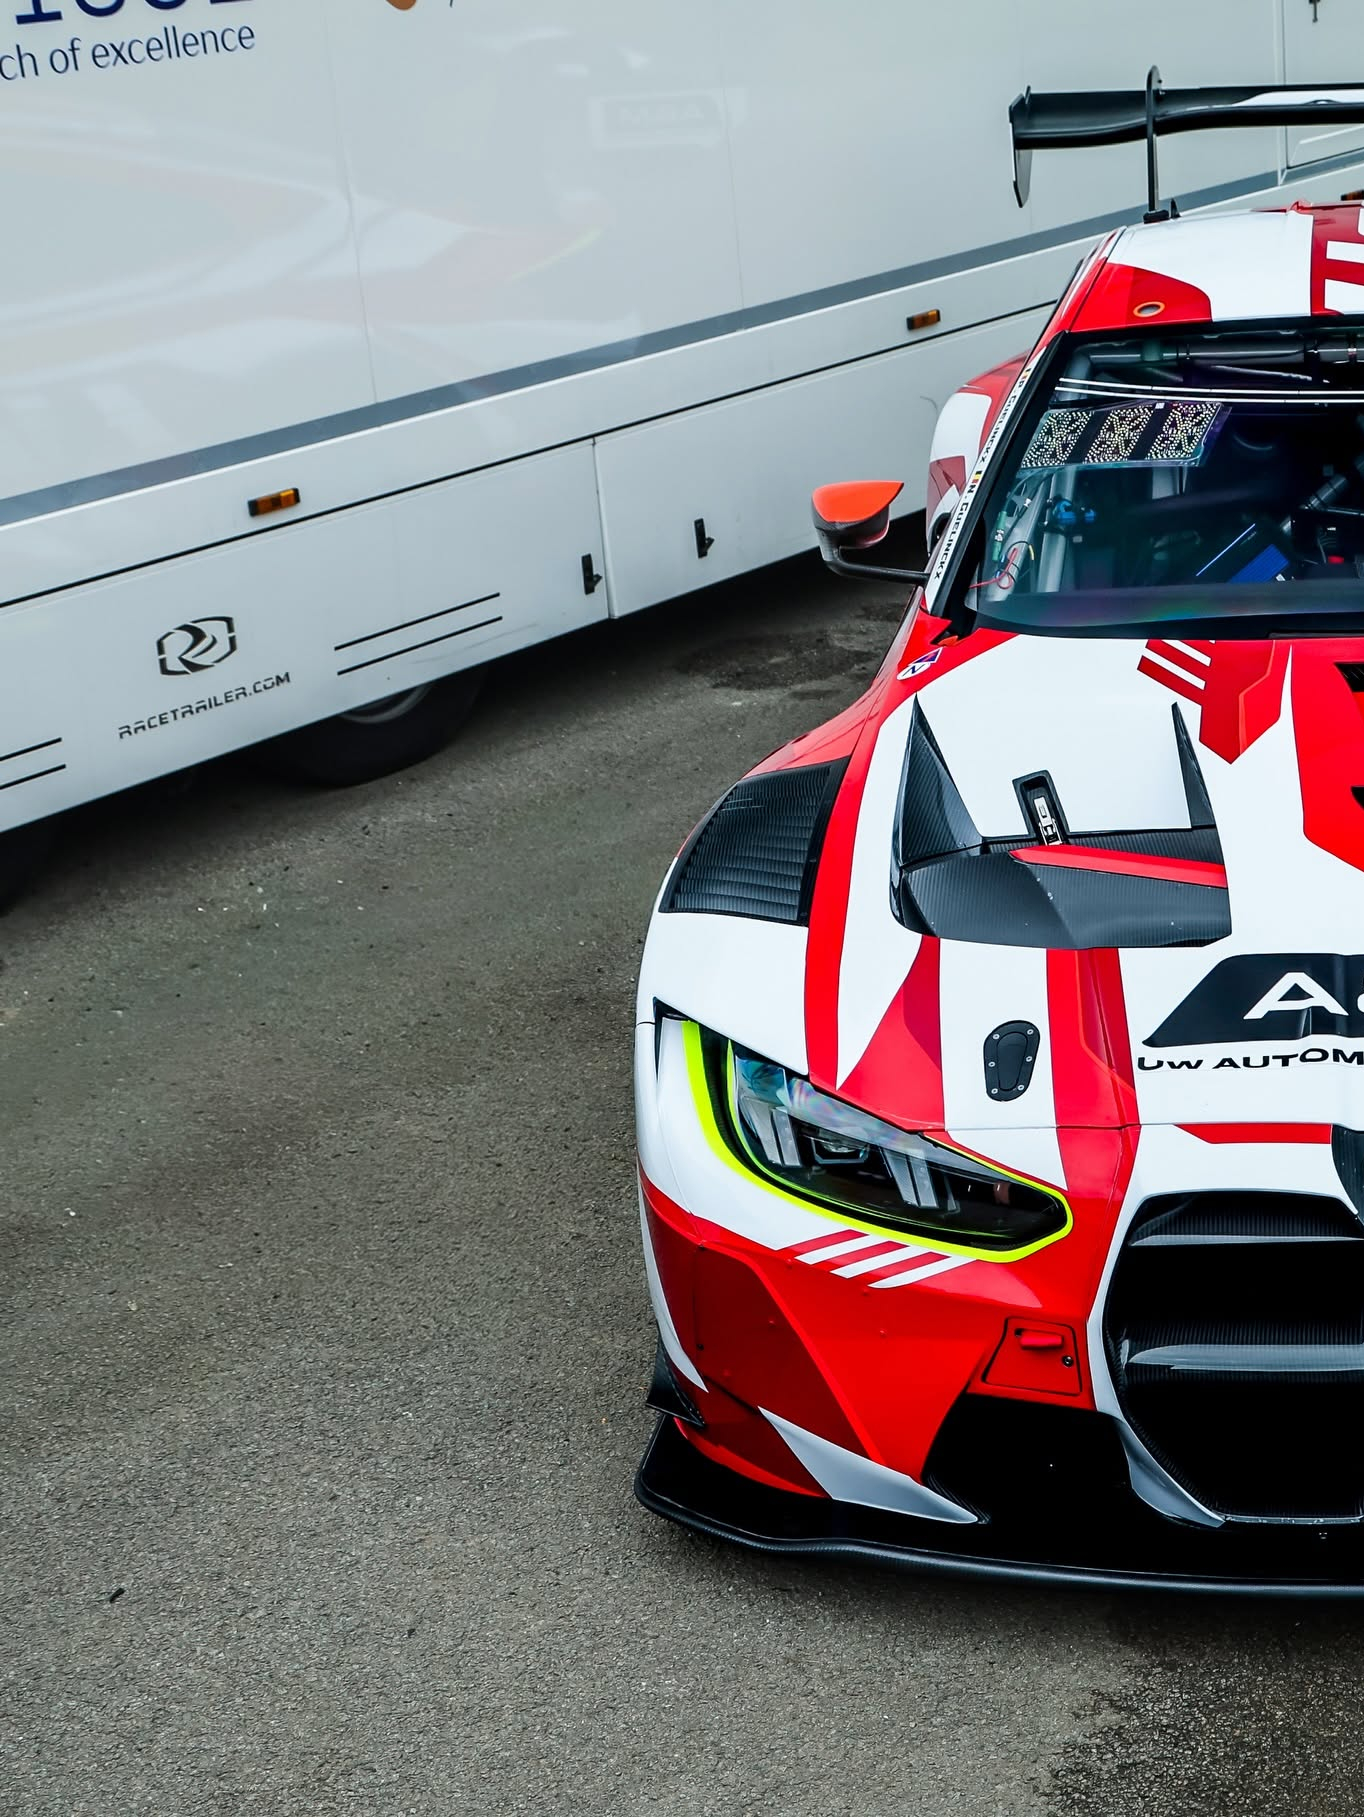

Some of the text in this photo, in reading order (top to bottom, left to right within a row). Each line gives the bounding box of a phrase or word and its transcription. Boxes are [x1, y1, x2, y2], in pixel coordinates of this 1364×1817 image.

[49, 37, 82, 74] of
[91, 24, 255, 69] excellence
[934, 484, 977, 579] N. GUELINCKX
[118, 672, 291, 739] RACETRAILER.COM
[1137, 1056, 1204, 1071] UW
